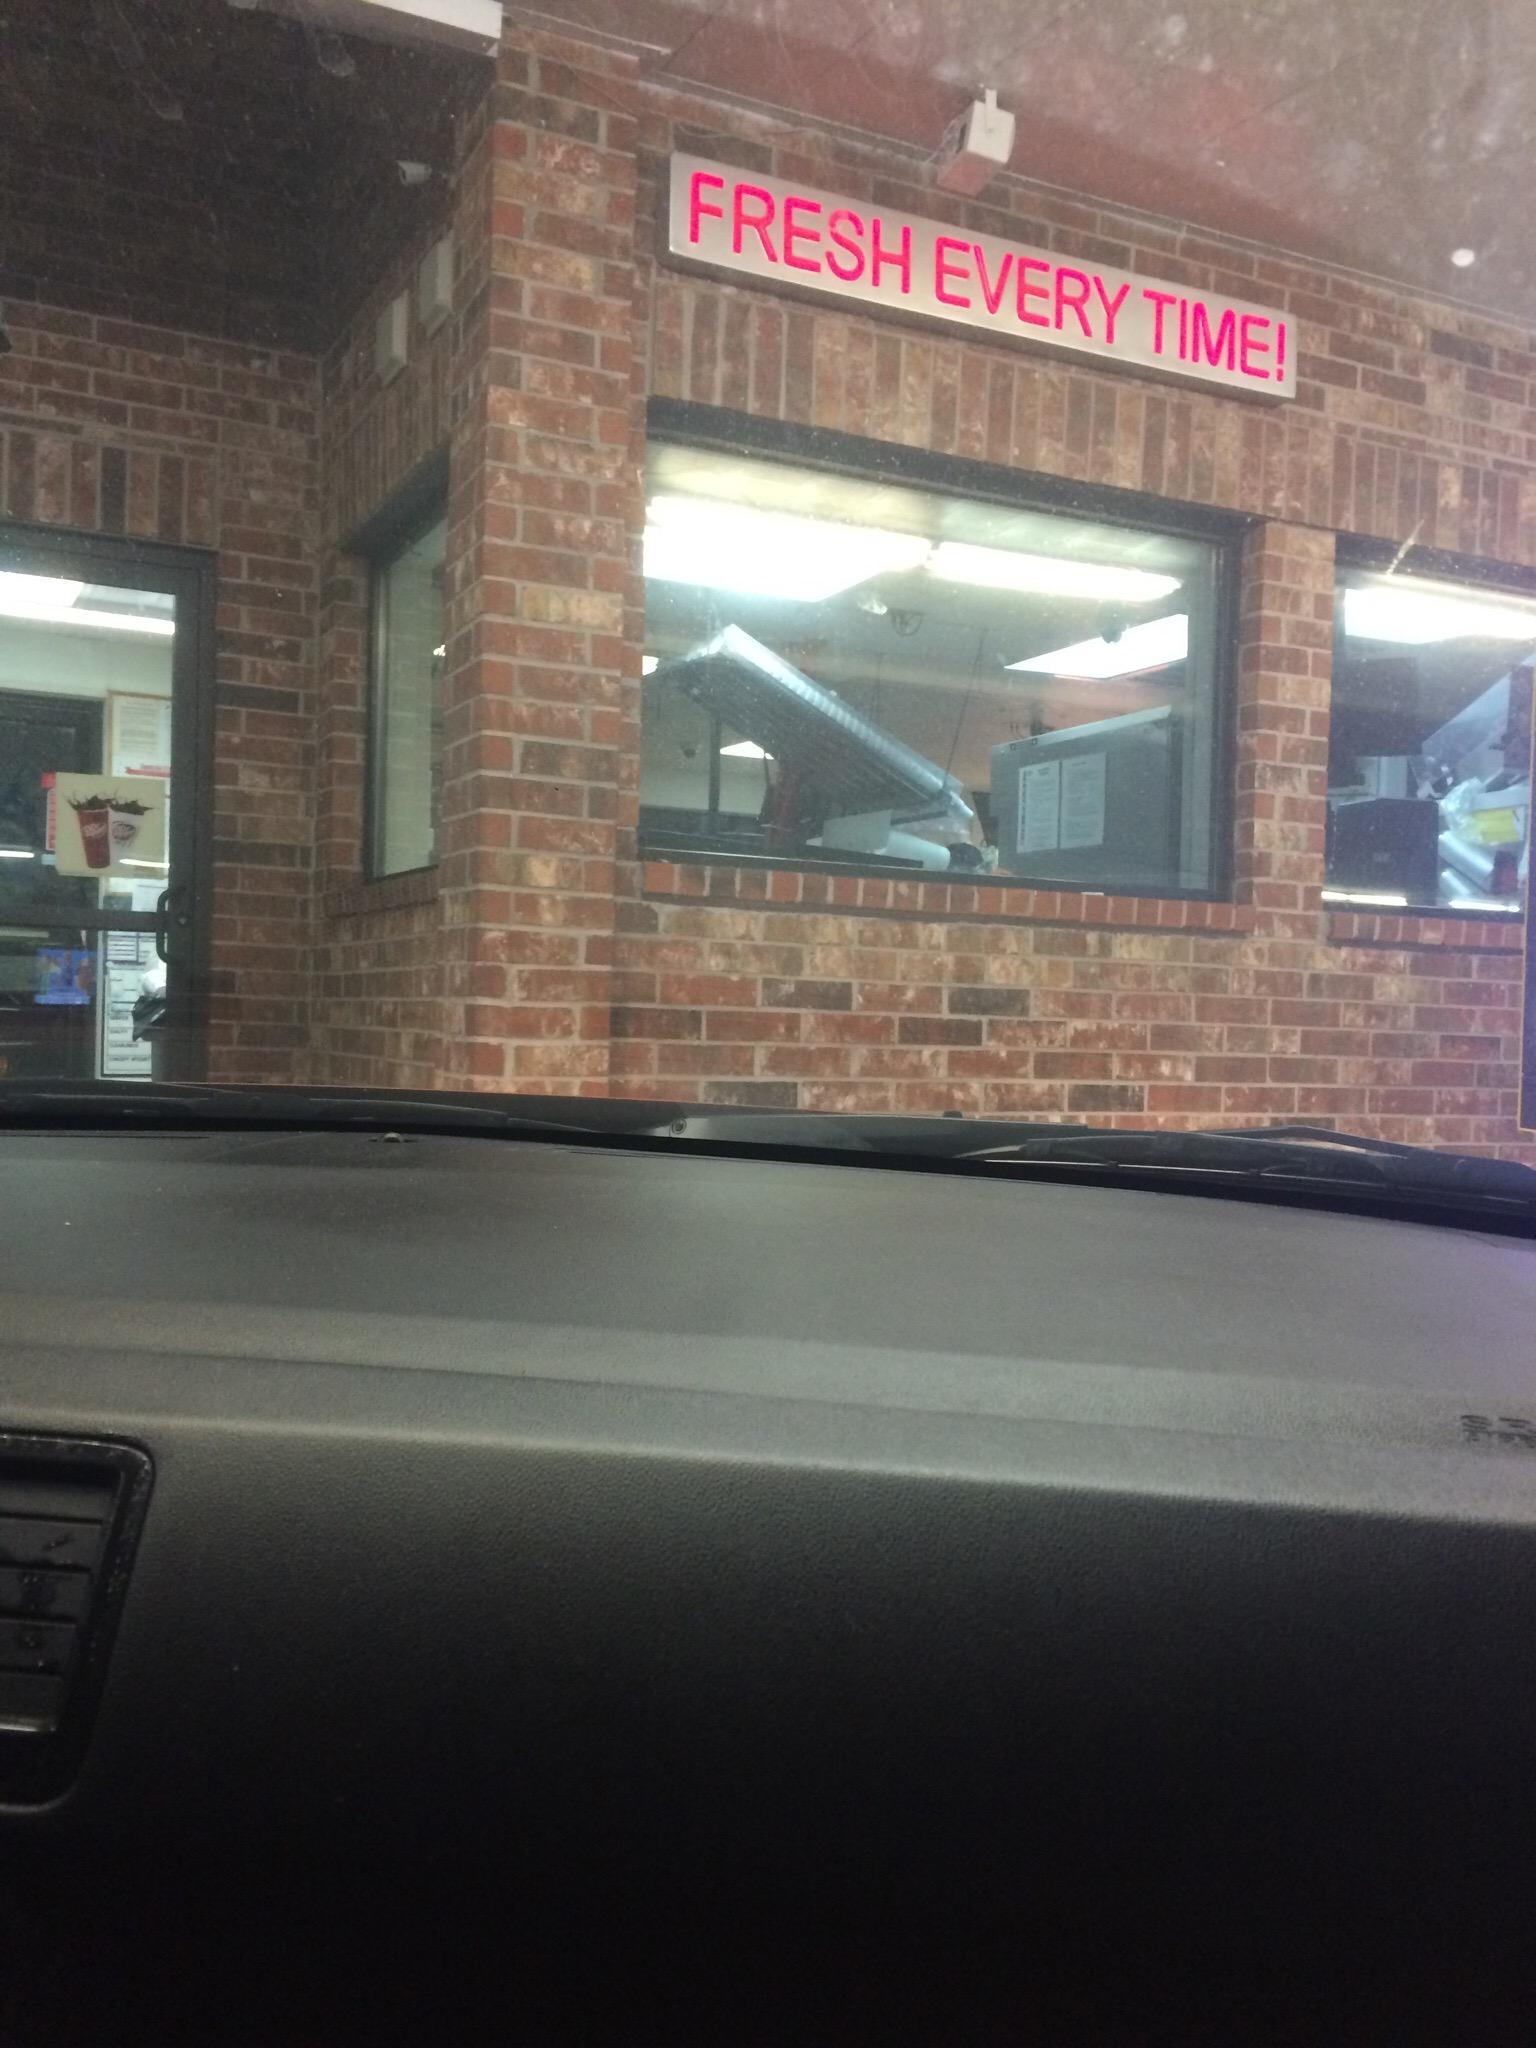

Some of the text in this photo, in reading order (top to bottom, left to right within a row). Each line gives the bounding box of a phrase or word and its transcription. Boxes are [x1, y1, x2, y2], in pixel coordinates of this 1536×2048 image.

[688, 170, 1288, 383] FRESH EVERY TIME!
